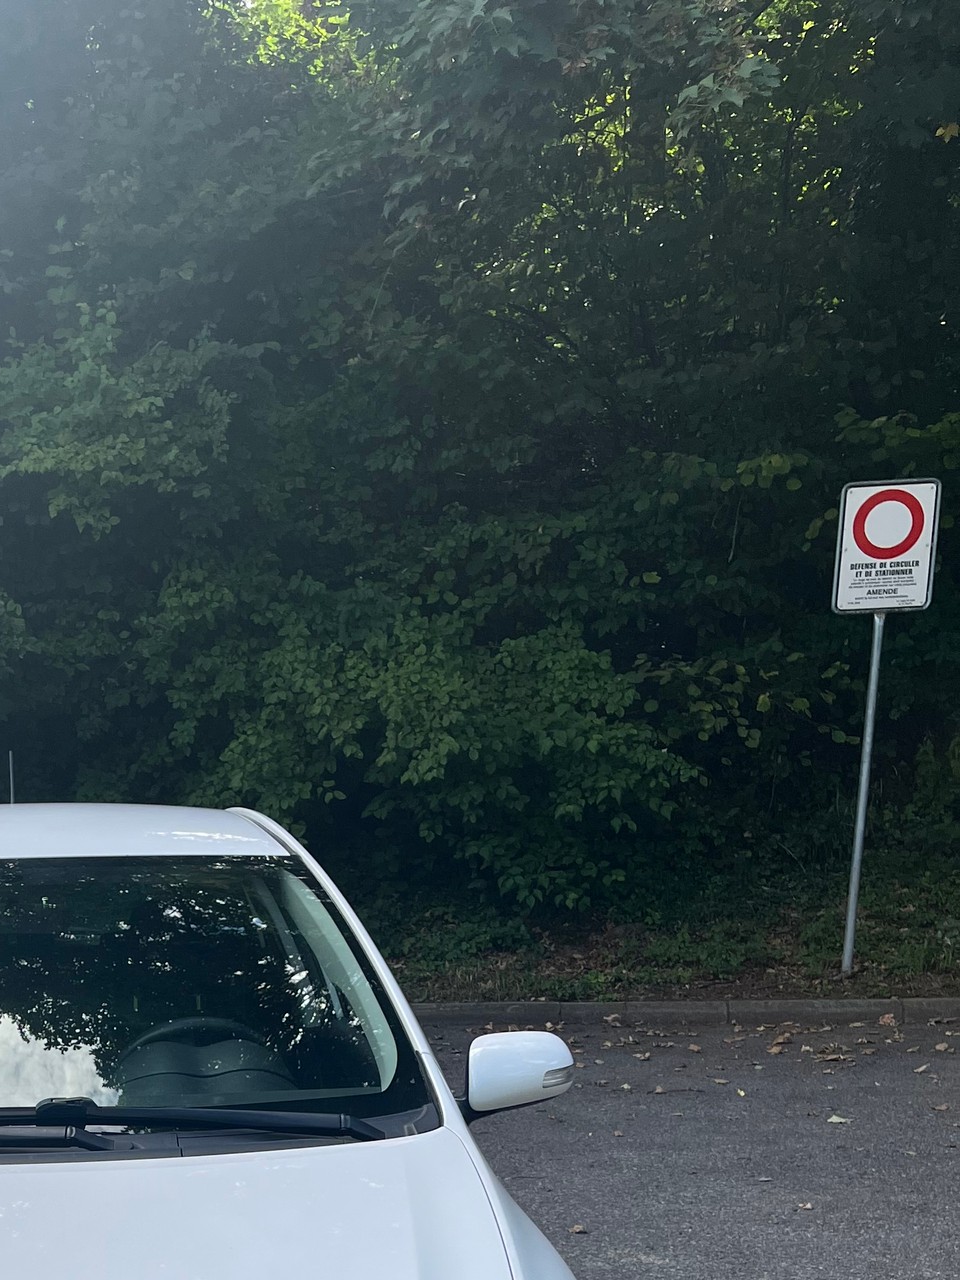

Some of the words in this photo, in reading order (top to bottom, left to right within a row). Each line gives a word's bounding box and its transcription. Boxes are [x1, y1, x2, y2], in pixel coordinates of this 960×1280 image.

[879, 561, 887, 569] DE
[889, 560, 920, 568] CIRCULER
[855, 570, 862, 578] ET
[874, 568, 913, 577] STATIONNER
